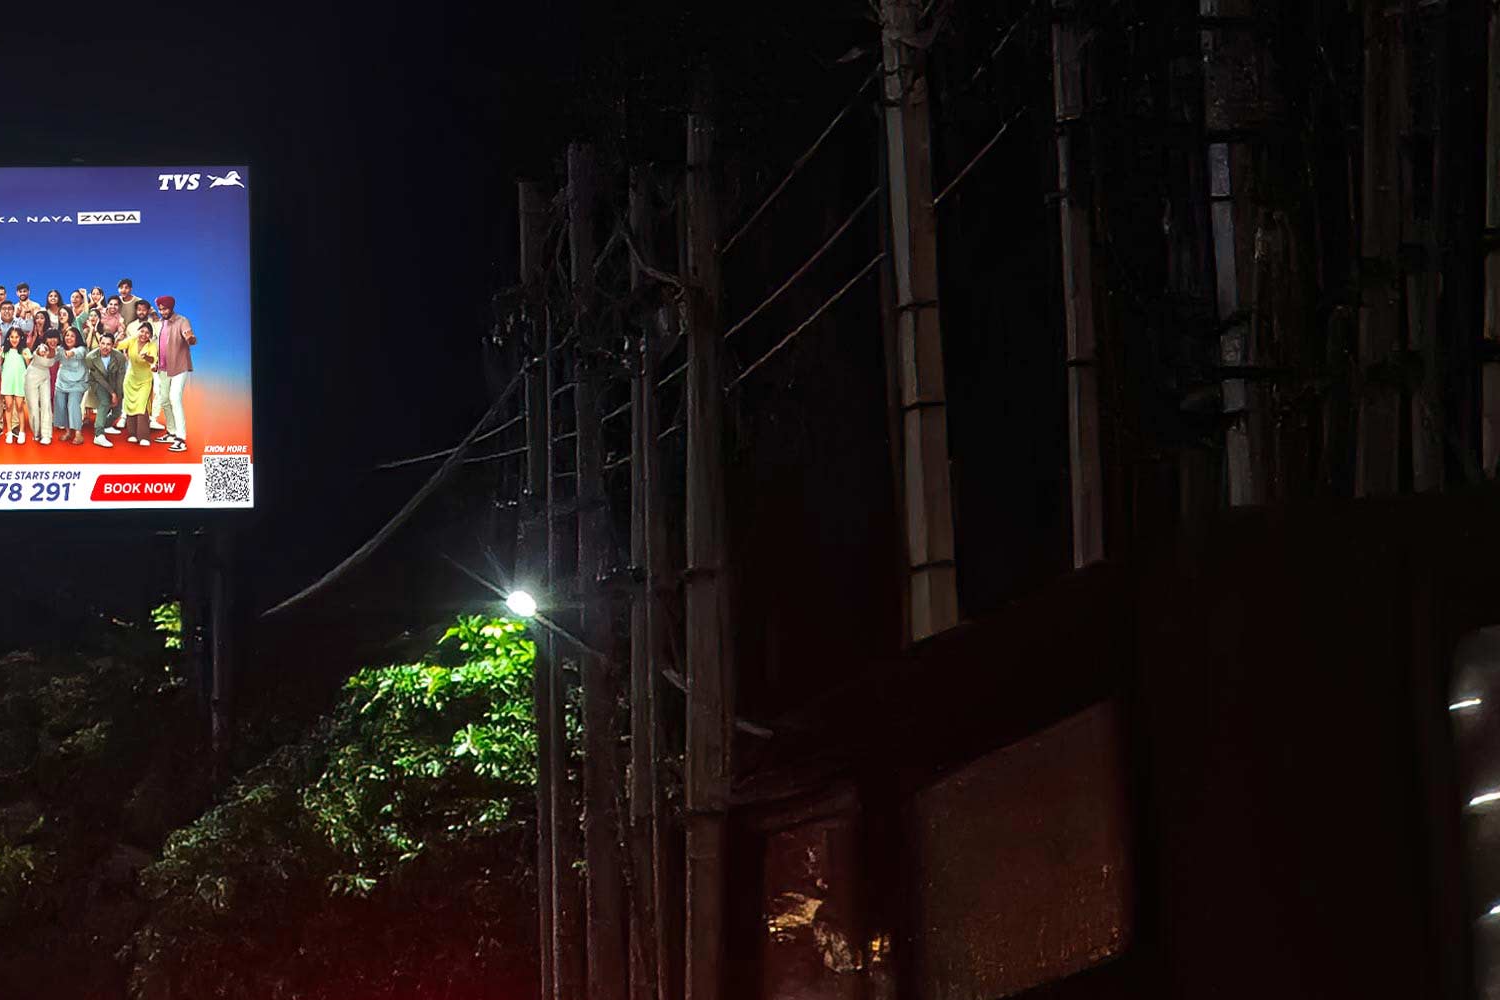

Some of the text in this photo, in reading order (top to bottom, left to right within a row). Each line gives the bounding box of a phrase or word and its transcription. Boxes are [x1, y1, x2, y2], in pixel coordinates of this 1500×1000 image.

[158, 173, 201, 191] TVS
[27, 215, 73, 224] NAYA
[80, 213, 138, 223] ZYADA
[14, 471, 51, 480] STARTS
[52, 471, 81, 480] FROM
[103, 482, 176, 494] BOOK NOW
